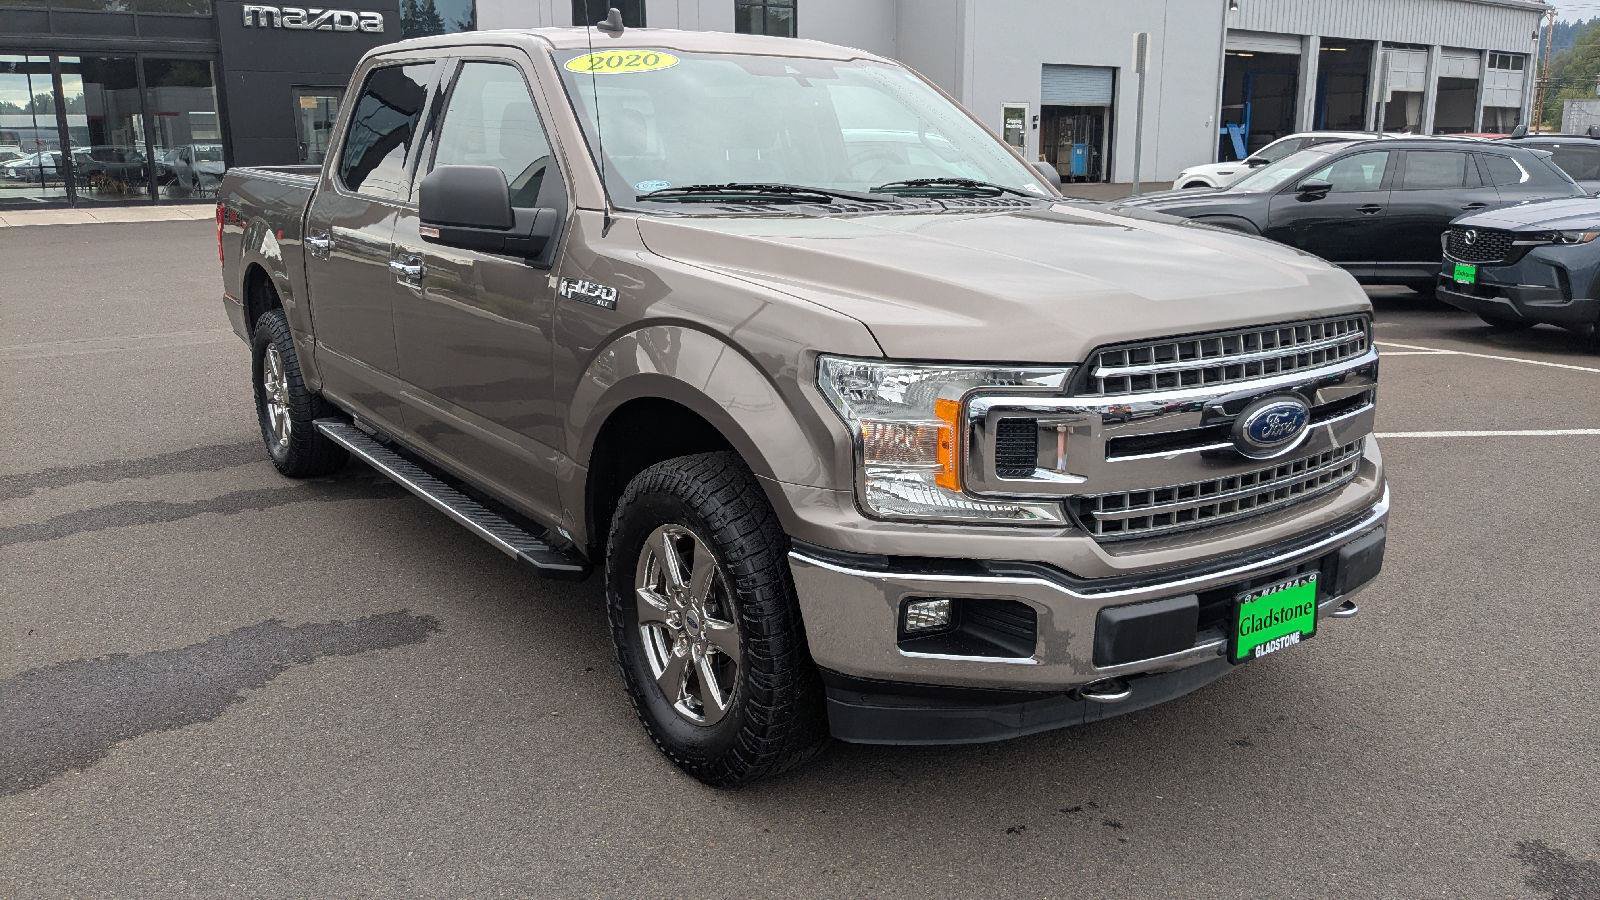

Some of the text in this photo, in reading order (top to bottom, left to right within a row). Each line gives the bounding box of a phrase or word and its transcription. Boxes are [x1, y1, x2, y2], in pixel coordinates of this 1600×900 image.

[587, 53, 660, 70] 2020
[1261, 411, 1298, 438] Ford
[1262, 579, 1300, 597] MAZDA
[1240, 601, 1313, 637] Gladstone
[1255, 631, 1300, 658] GLADSTONE
